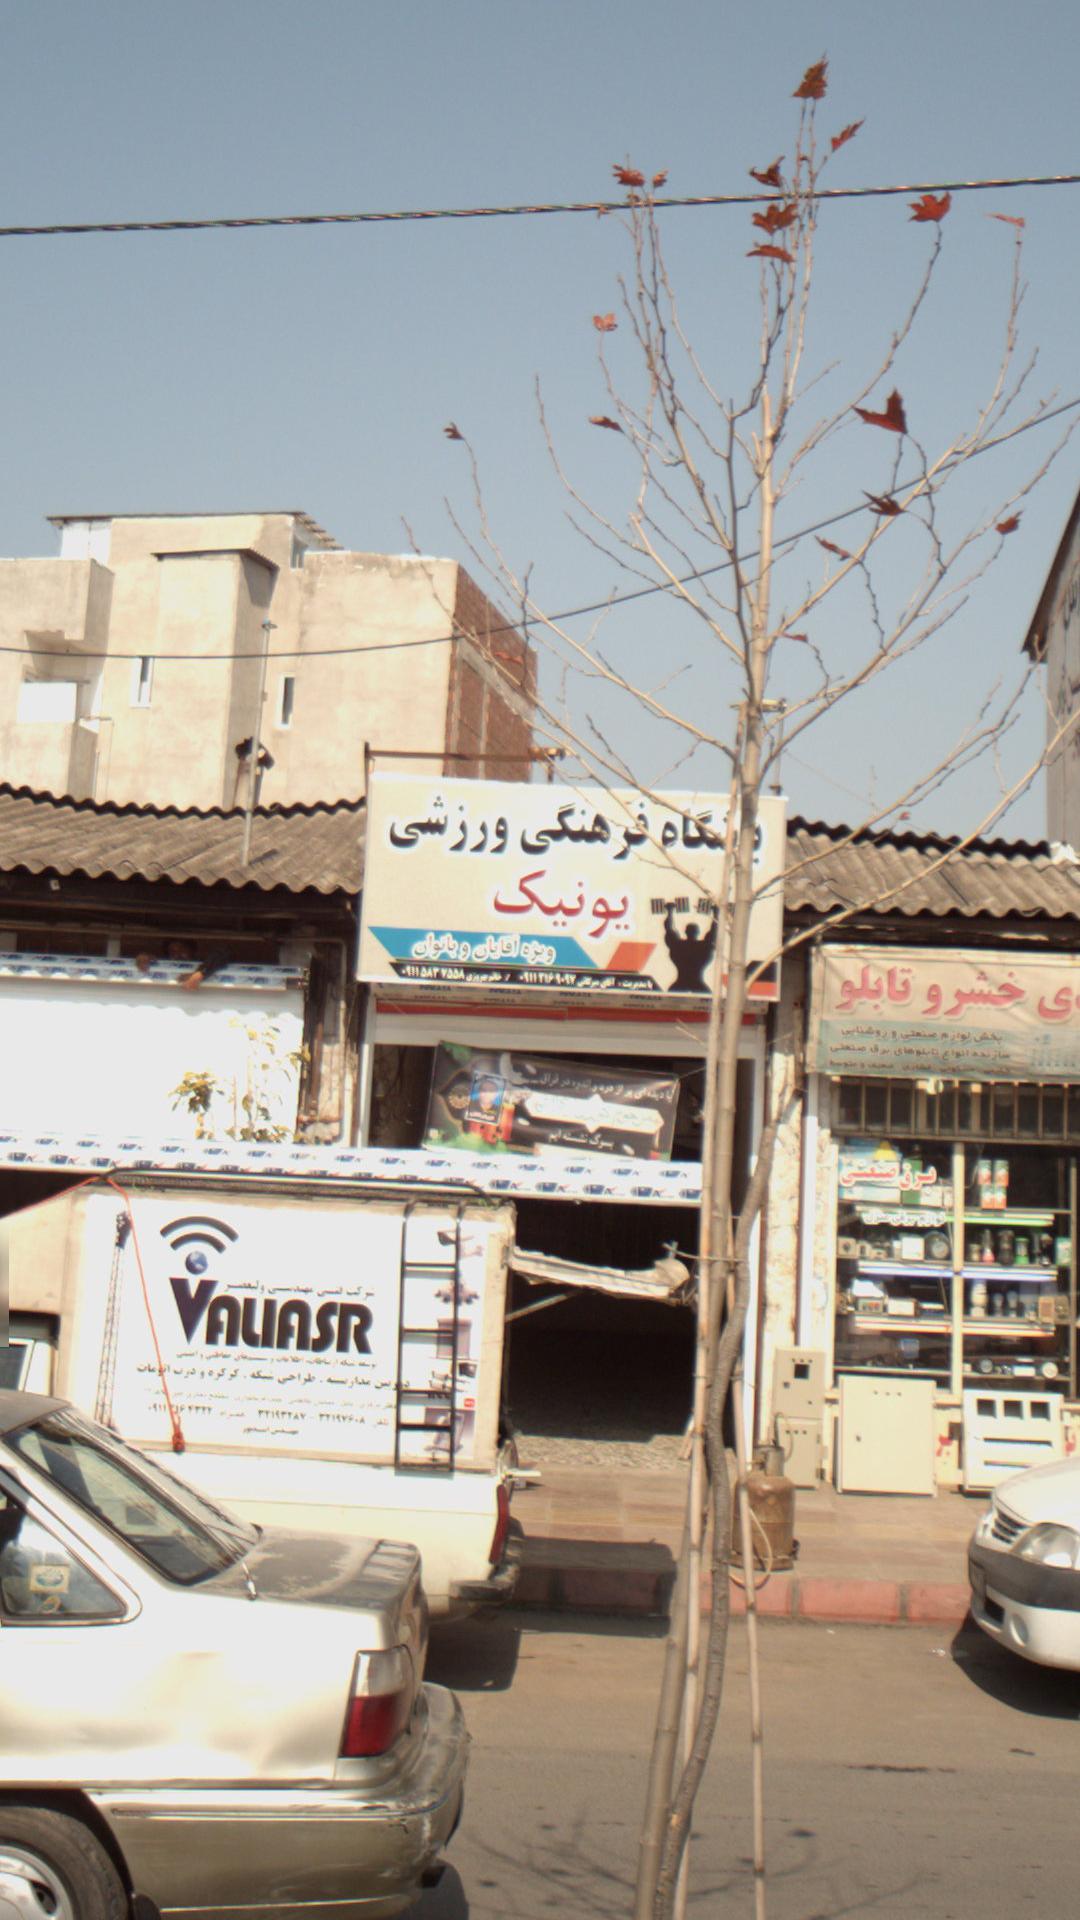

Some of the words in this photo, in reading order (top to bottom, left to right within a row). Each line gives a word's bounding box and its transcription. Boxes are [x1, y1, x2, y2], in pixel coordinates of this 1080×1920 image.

[389, 795, 508, 853] ورزشی
[520, 802, 650, 859] فرهنگی
[493, 870, 630, 937] یونیک
[413, 933, 459, 958] بانوان
[459, 942, 470, 959] و
[472, 936, 521, 961] آقایان
[522, 941, 556, 964] ویژه
[835, 965, 912, 1011] تابلو
[840, 1025, 888, 1039] روشنایی
[900, 1029, 937, 1040] صنعتی
[940, 1031, 971, 1042] لوازم
[973, 1031, 1003, 1044] پخش
[899, 1163, 937, 1190] برق
[268, 1284, 313, 1295] مهندسی
[168, 1277, 373, 1354] VALIASR
[277, 1372, 317, 1385] طراحی
